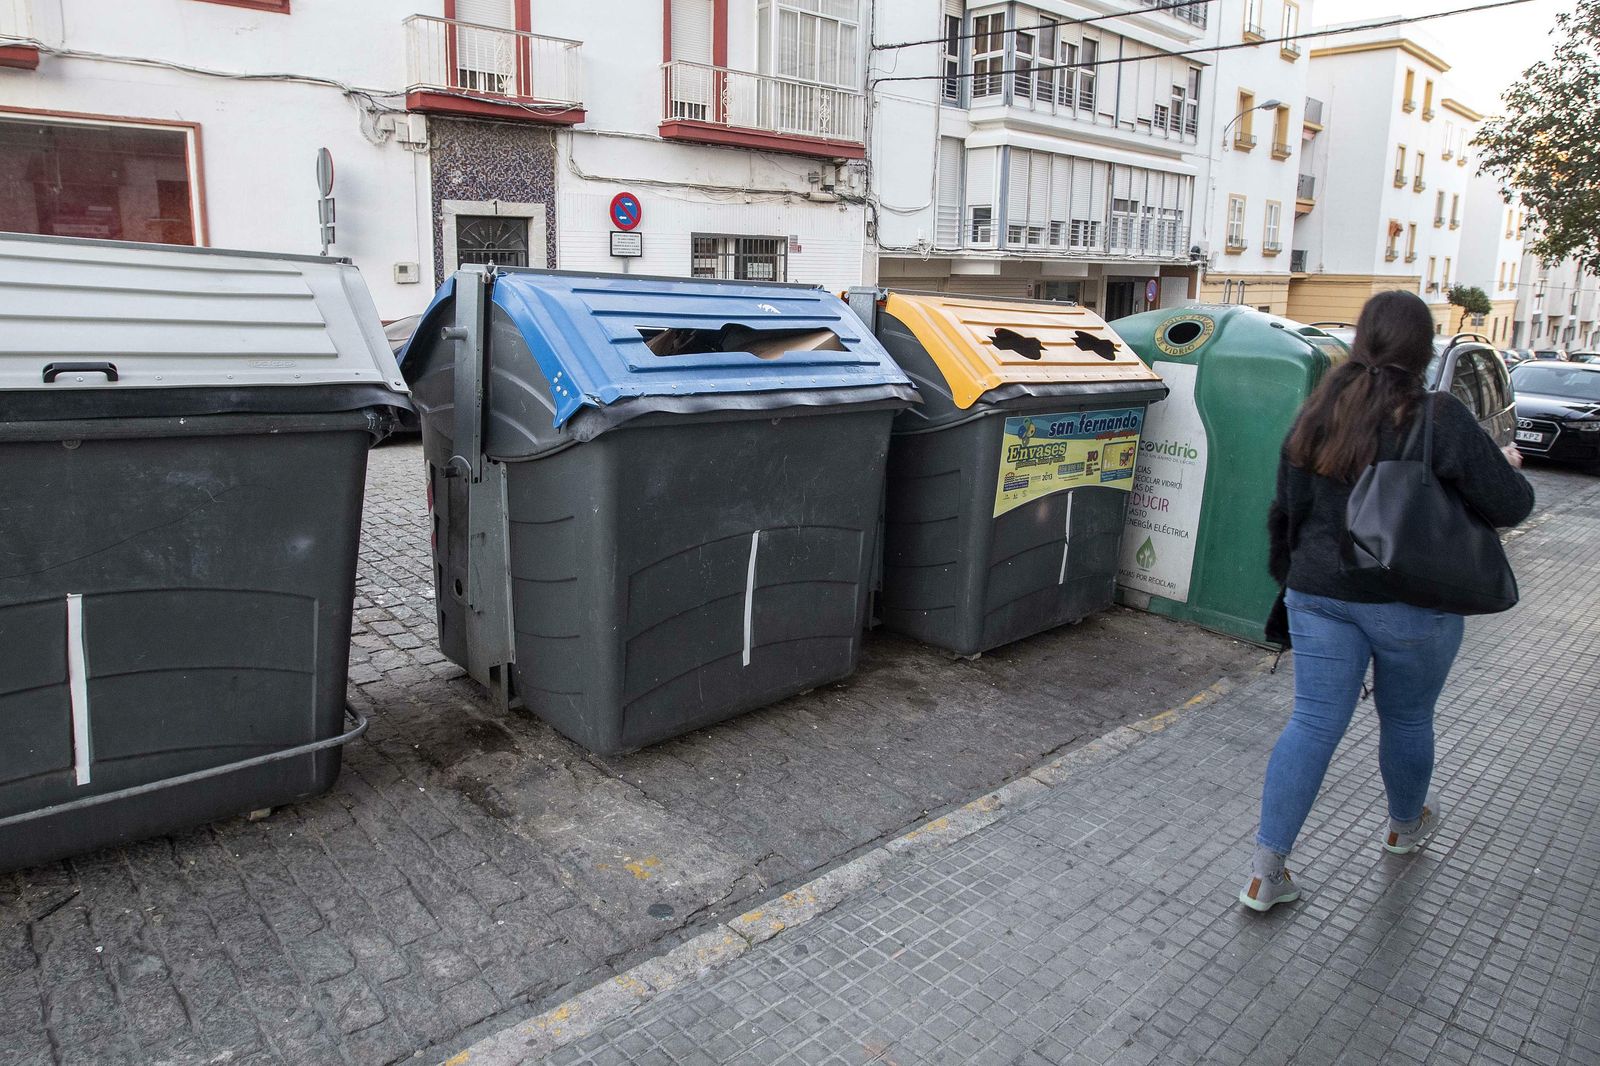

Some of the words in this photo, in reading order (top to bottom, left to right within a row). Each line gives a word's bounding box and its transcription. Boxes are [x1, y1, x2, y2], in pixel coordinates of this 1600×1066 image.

[492, 200, 498, 215] 1
[1156, 336, 1165, 347] DE
[1164, 344, 1195, 355] VIDRIO
[1048, 419, 1074, 437] san
[1078, 411, 1138, 433] fernando
[1007, 441, 1067, 463] Envases
[1145, 484, 1154, 494] DE
[1130, 492, 1170, 513] DUCIR
[1153, 523, 1189, 539] ELÉCTRICA
